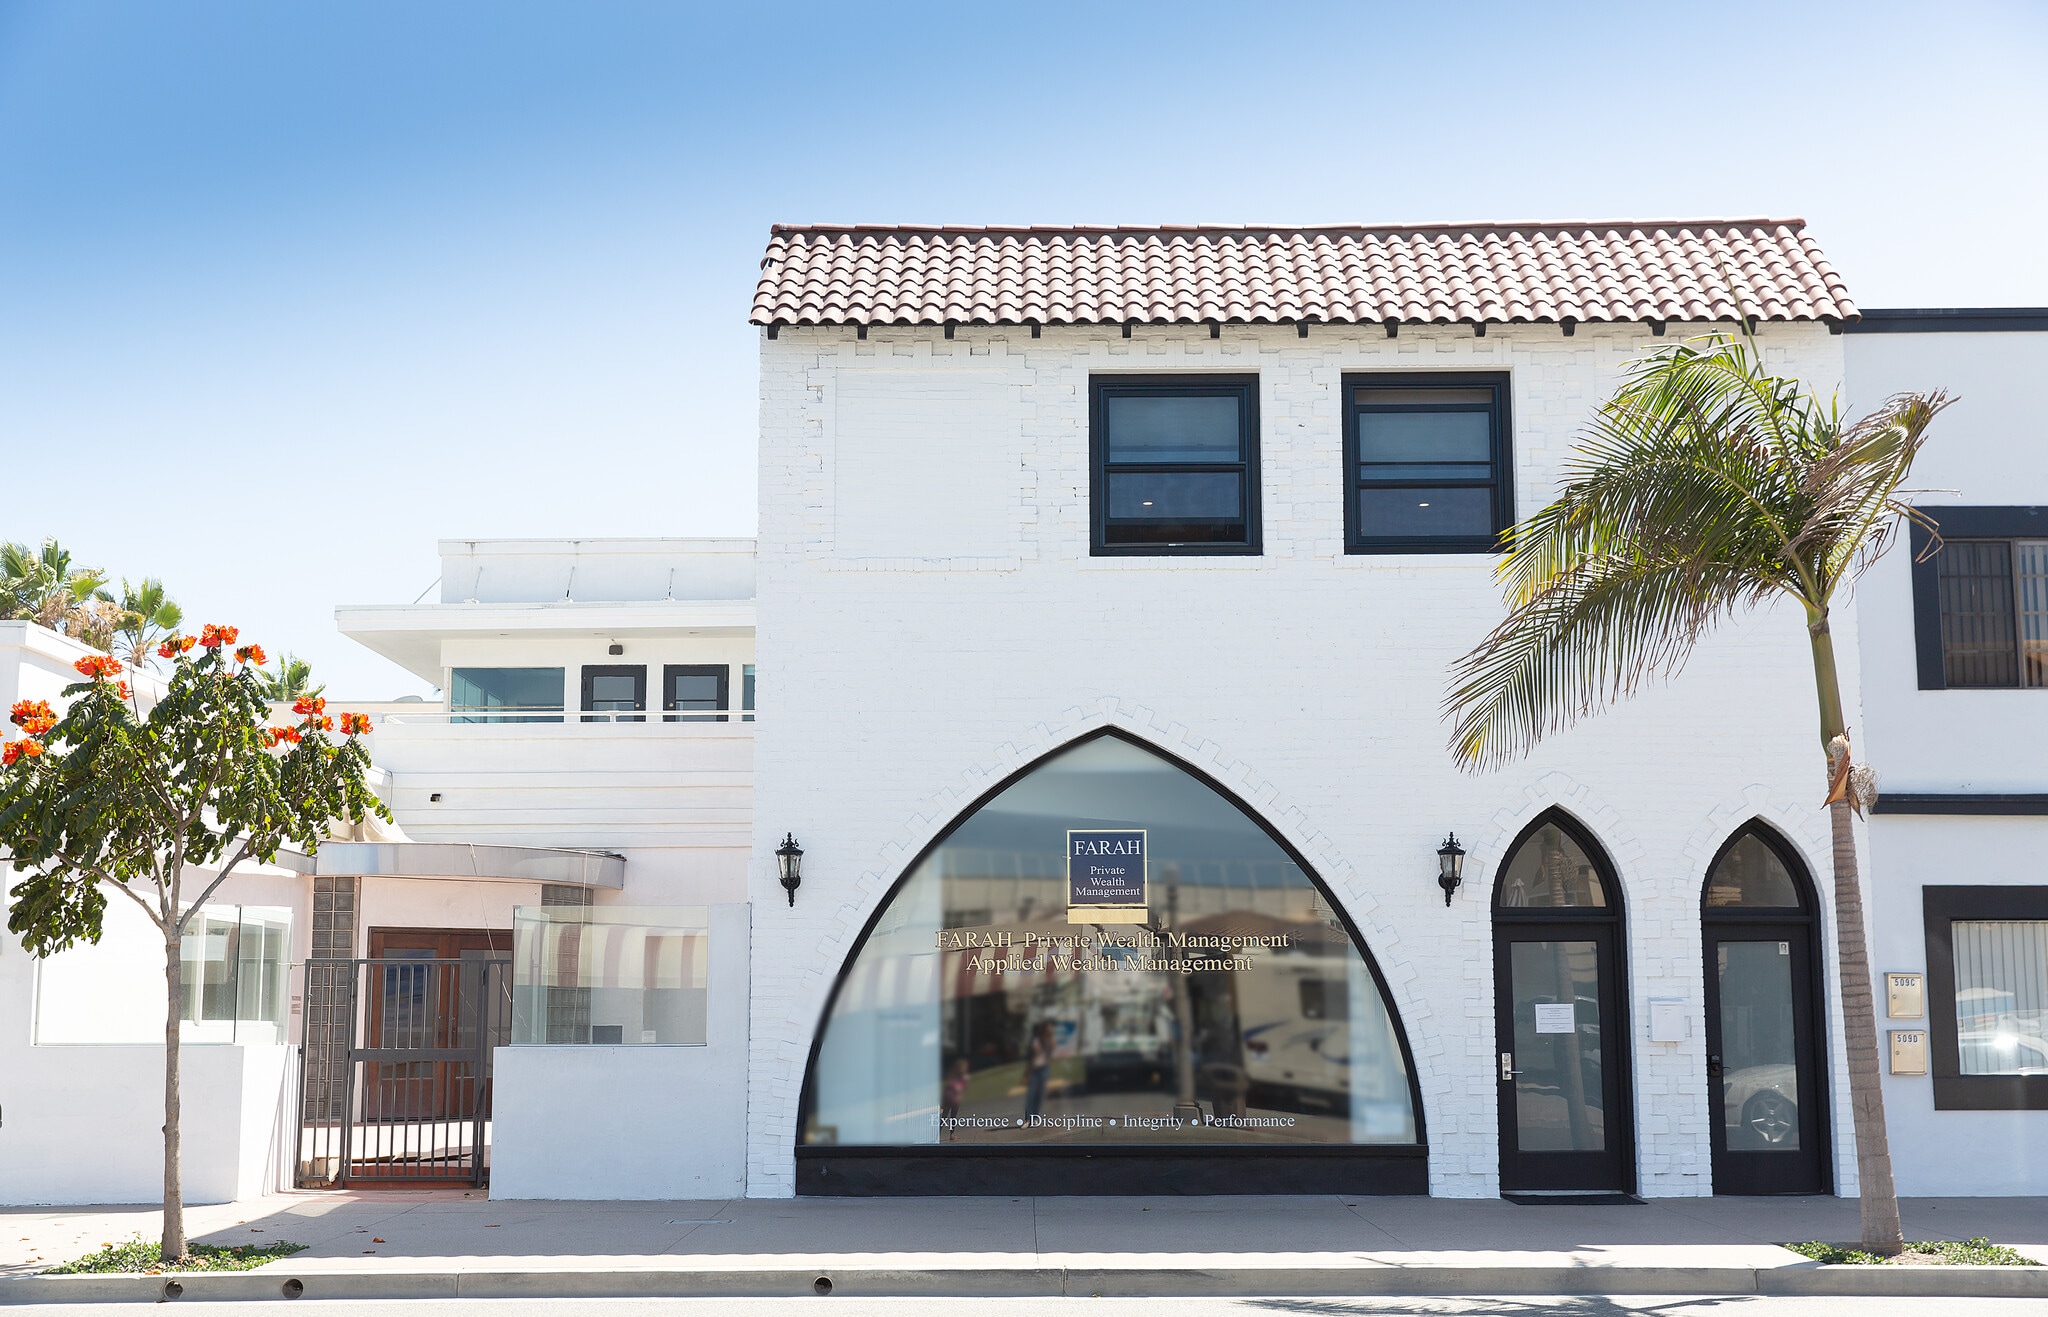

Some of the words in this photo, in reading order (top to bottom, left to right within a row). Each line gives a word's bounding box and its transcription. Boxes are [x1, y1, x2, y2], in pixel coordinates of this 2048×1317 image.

[1074, 839, 1142, 856] FARAH
[1089, 865, 1126, 875] Private
[1090, 877, 1125, 887] Wealth
[1075, 887, 1141, 898] Management
[935, 931, 1013, 948] FARAH
[1023, 931, 1092, 948] Private
[1096, 931, 1162, 948] Wealth
[1167, 931, 1289, 952] Management
[966, 953, 1045, 975] Applied
[1049, 954, 1119, 972] Wealth
[1123, 954, 1254, 975] Management
[1894, 978, 1916, 987] 509C
[1897, 1034, 1918, 1043] 509D
[929, 1114, 1010, 1131] Experience
[1029, 1114, 1103, 1131] Discipline
[1123, 1114, 1185, 1131] Integrity
[1204, 1113, 1296, 1128] Performance
